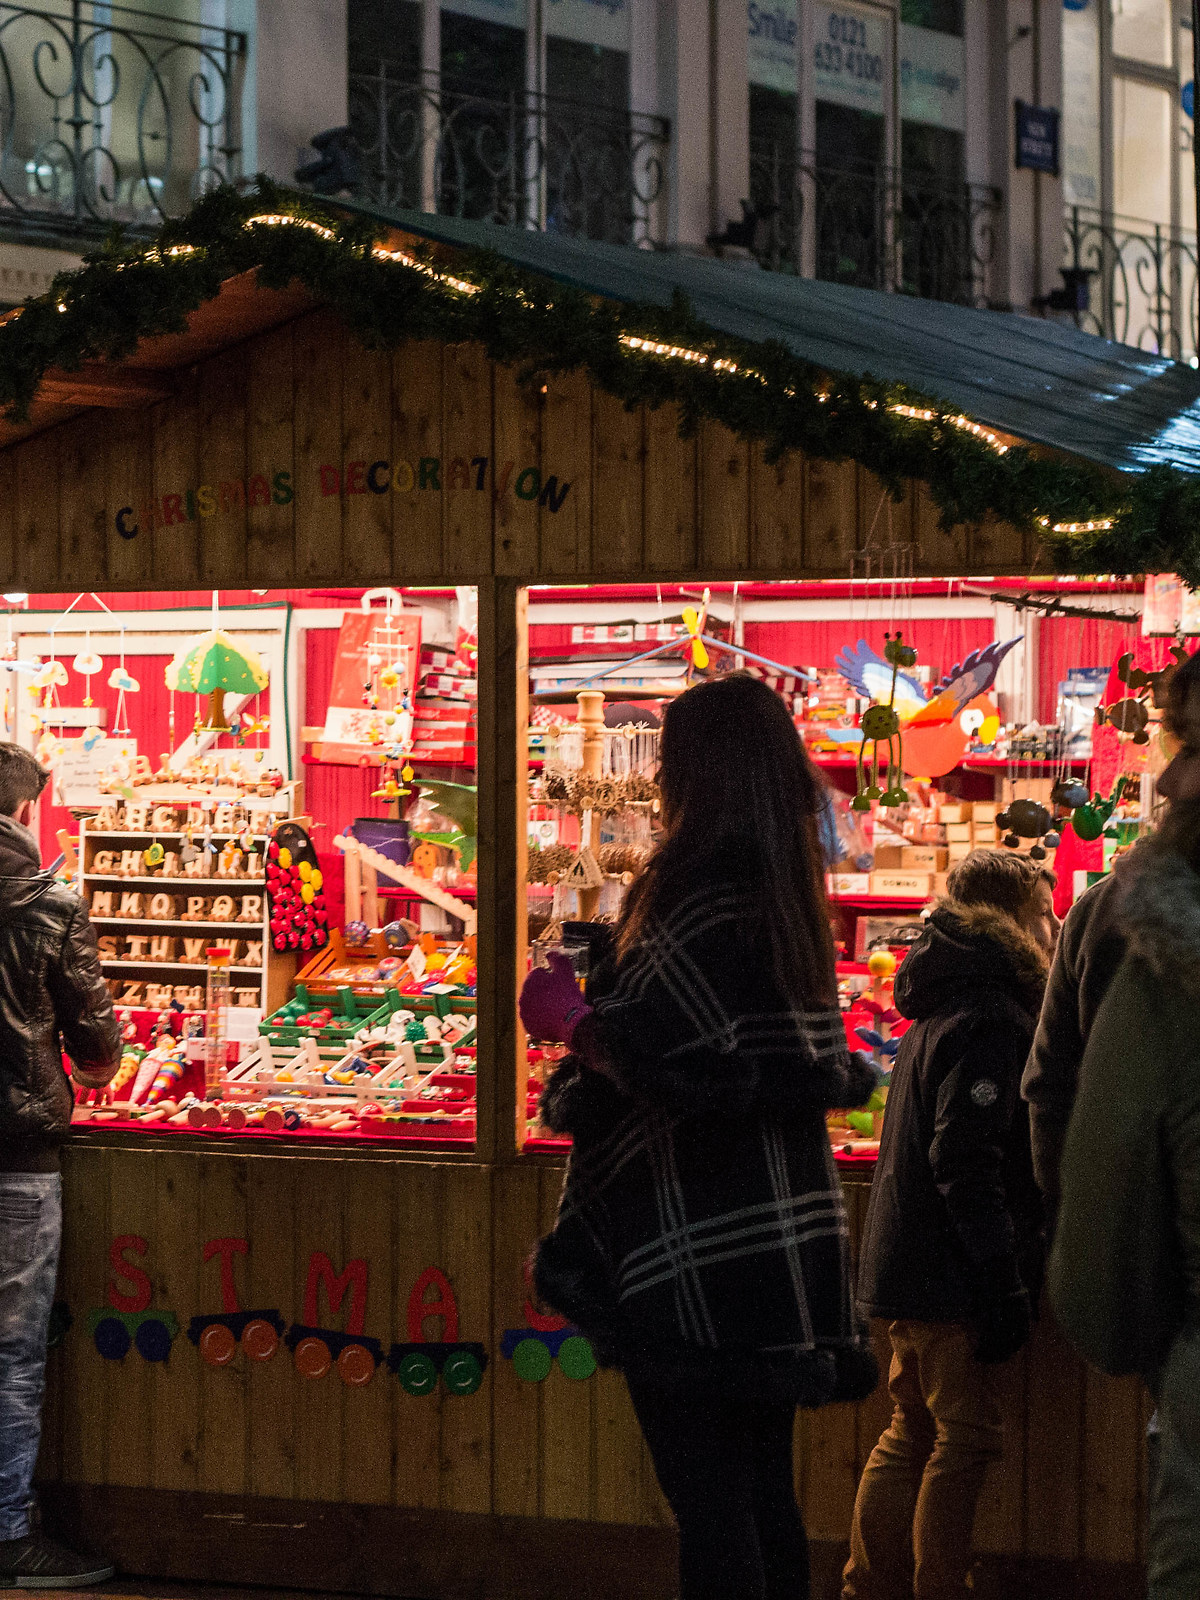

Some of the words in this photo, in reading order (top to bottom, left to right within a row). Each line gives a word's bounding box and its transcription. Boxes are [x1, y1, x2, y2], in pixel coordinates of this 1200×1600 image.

[748, 3, 797, 47] Smile
[828, 13, 866, 48] 0121
[320, 456, 570, 514] DECORATION
[882, 879, 918, 887] DOMINO
